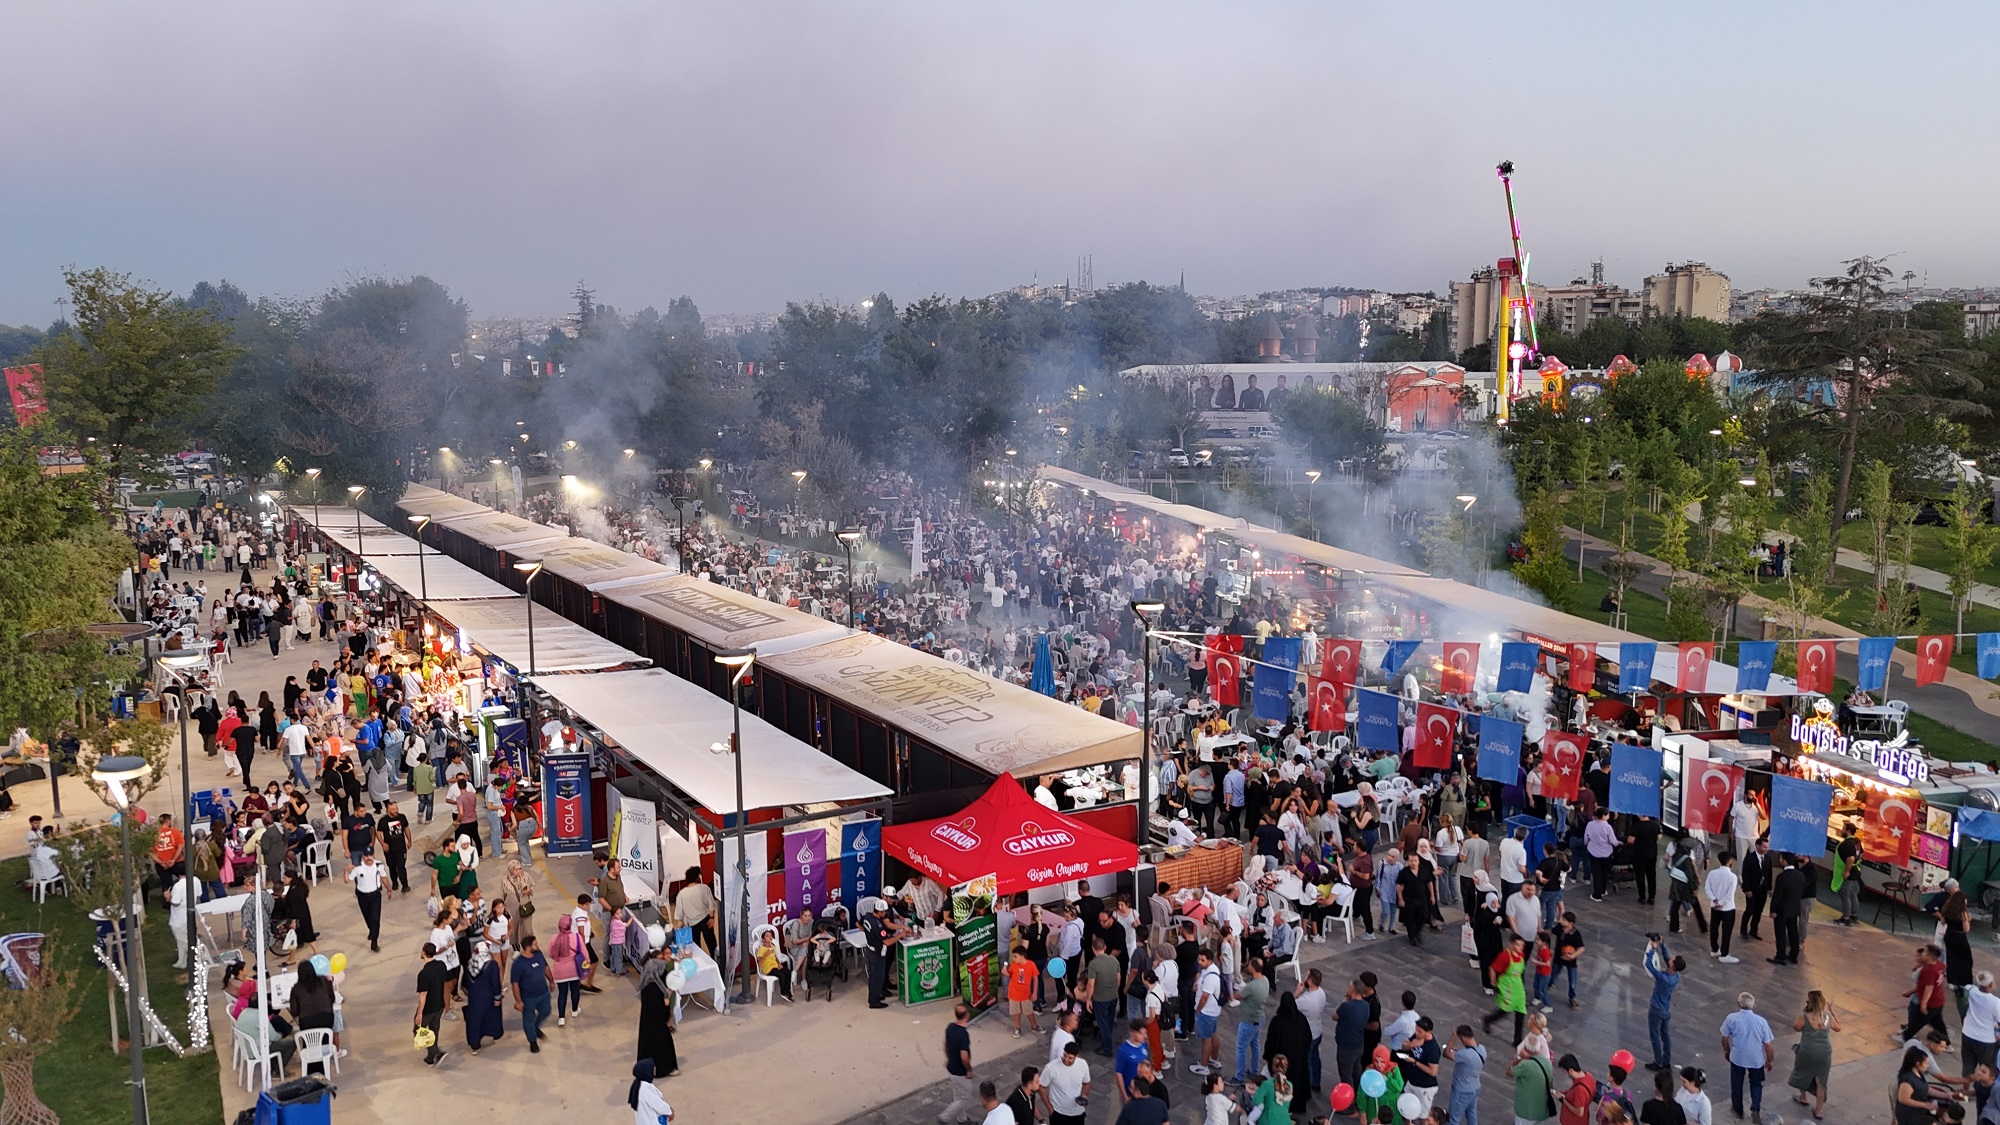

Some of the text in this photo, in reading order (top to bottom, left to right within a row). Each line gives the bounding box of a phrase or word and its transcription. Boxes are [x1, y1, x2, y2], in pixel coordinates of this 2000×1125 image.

[1790, 714, 1930, 783] Barista's Coffee
[564, 803, 575, 833] COLA
[935, 824, 977, 849] ÇAYKUR
[1008, 832, 1071, 854] ÇAYKUR
[620, 859, 653, 871] GASKİ
[1027, 866, 1055, 883] Bizim
